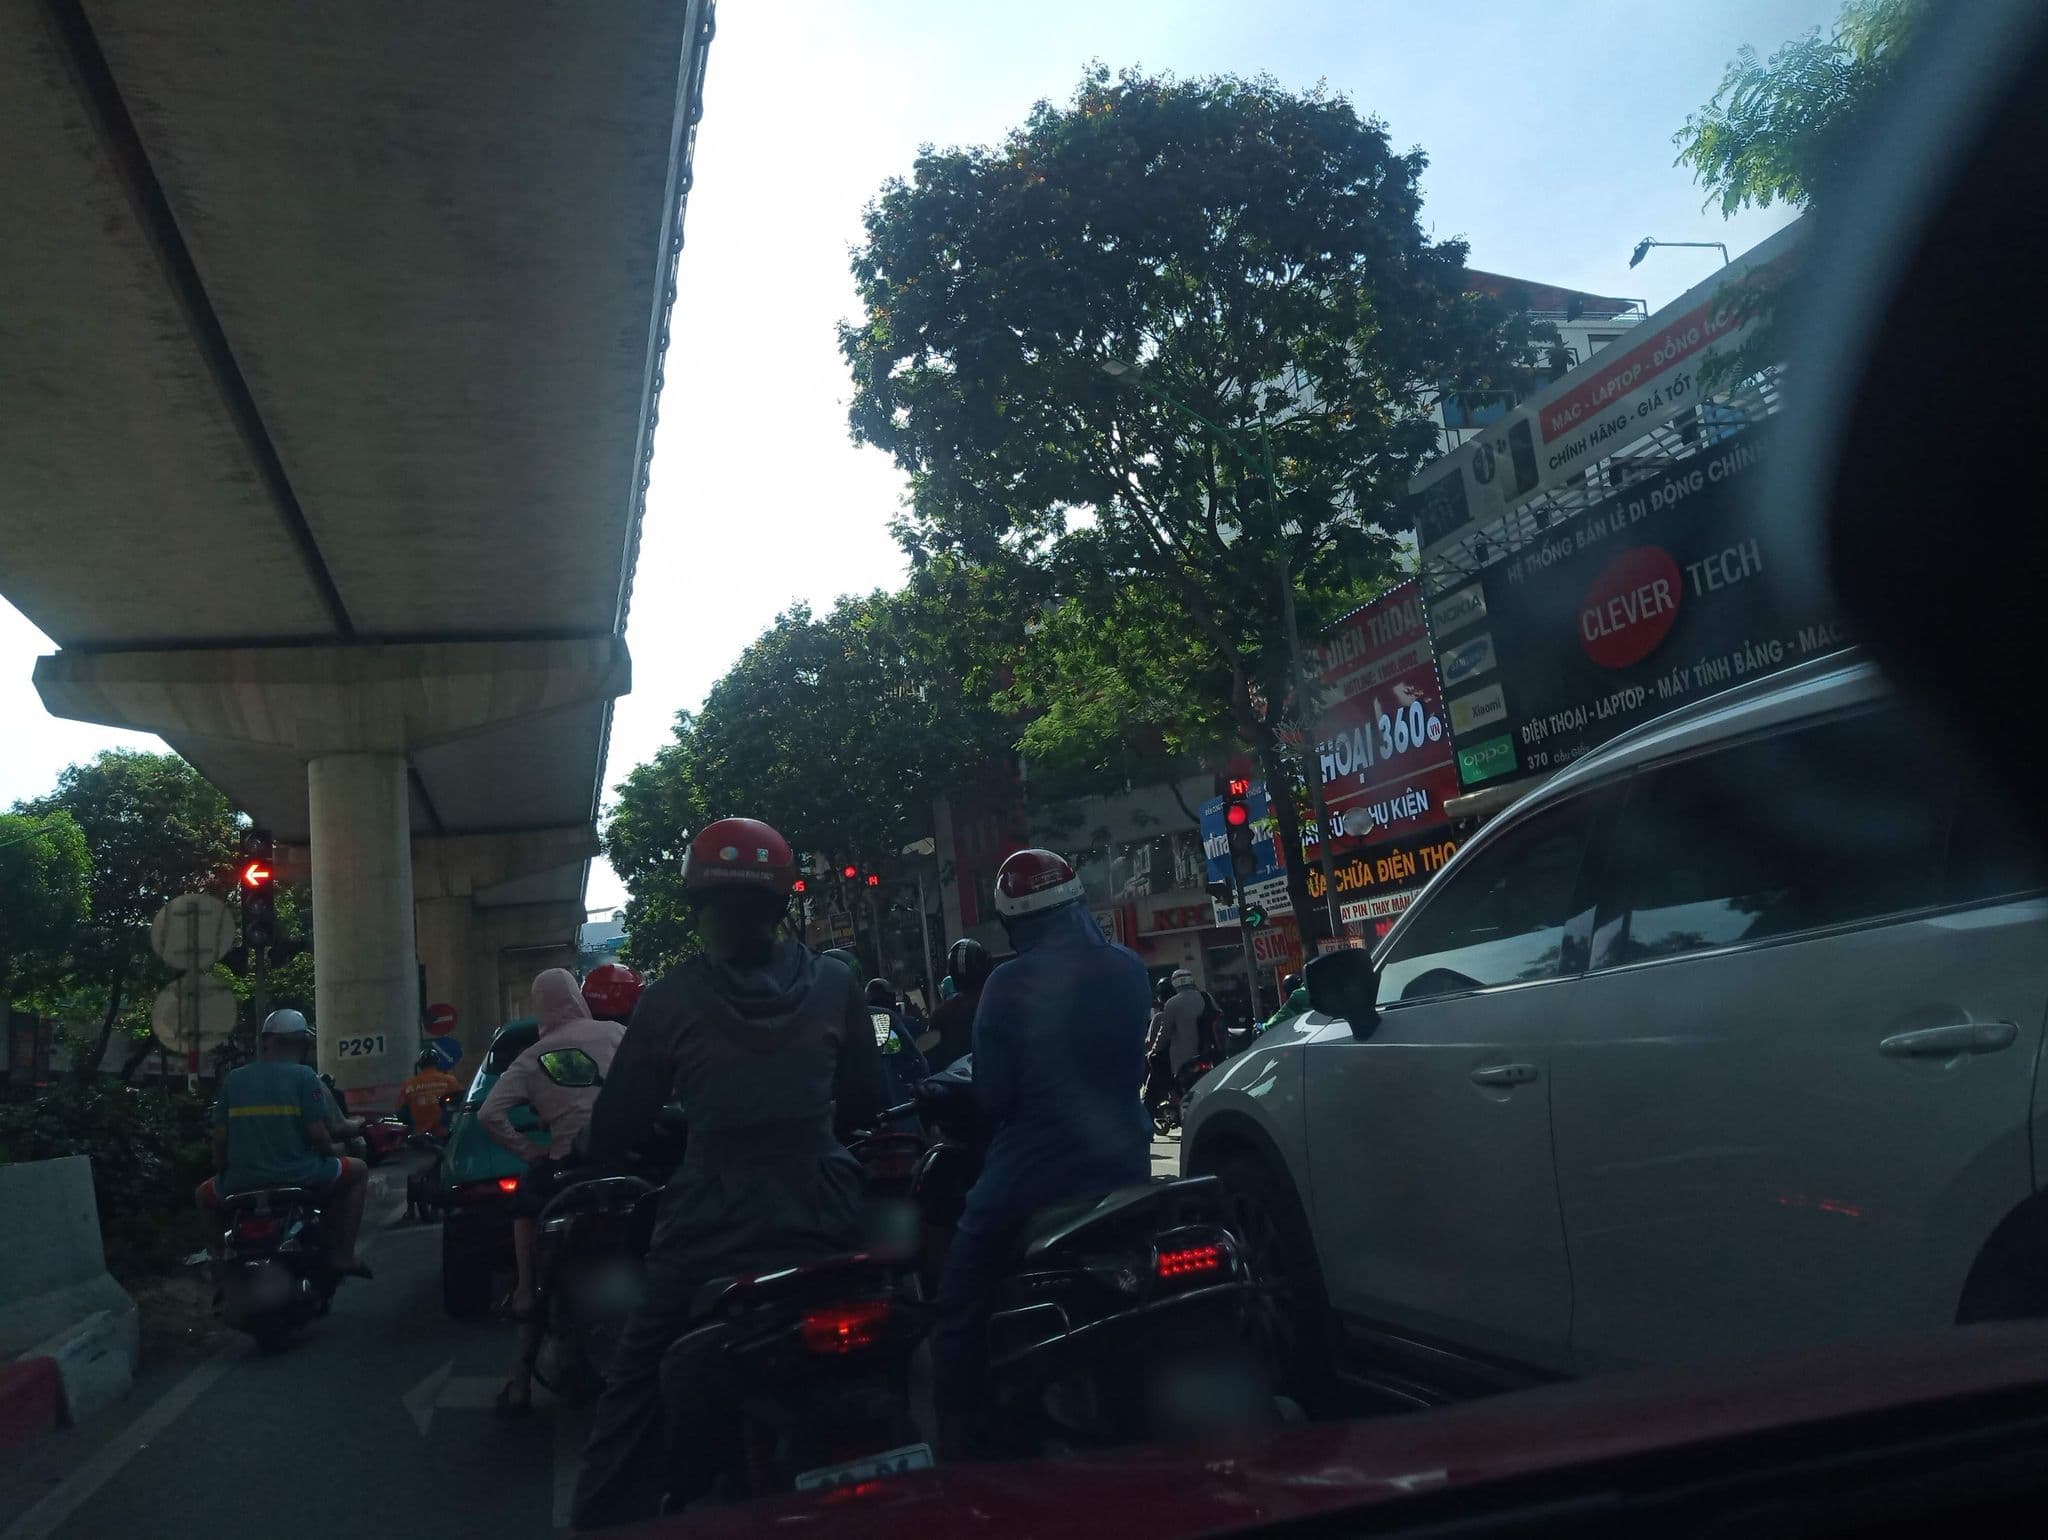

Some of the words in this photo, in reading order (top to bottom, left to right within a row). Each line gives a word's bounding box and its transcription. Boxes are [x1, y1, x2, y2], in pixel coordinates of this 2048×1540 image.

[1552, 403, 1582, 432] MAC
[1591, 363, 1641, 406] LAPTOP
[1549, 433, 1587, 471] CHÍNH
[1636, 390, 1664, 418] GIÁ
[1665, 373, 1692, 401] TỐT
[1629, 498, 1648, 525] DI
[1582, 577, 1676, 641] CLEVER
[1686, 538, 1764, 597] TECH
[1435, 595, 1482, 625] NOKIA
[1521, 719, 1549, 746] ĐIỆN
[1550, 702, 1590, 736] THOẠI
[1595, 686, 1646, 719] LAPTOP
[1657, 665, 1693, 700] MÁY
[1694, 655, 1732, 688] TÍNH
[1733, 639, 1784, 674] BẢNG
[1471, 697, 1502, 718] Xiaomi
[1377, 699, 1425, 760] 360
[1527, 750, 1549, 770] 370
[1391, 787, 1430, 821] KIỆN
[1334, 858, 1375, 893] CHỮA
[1376, 849, 1417, 885] ĐIỆN
[1153, 902, 1212, 931] KFC
[1352, 903, 1368, 917] PIN
[1371, 899, 1390, 915] THAY
[1255, 933, 1287, 961] SIM
[338, 1035, 384, 1057] P291
